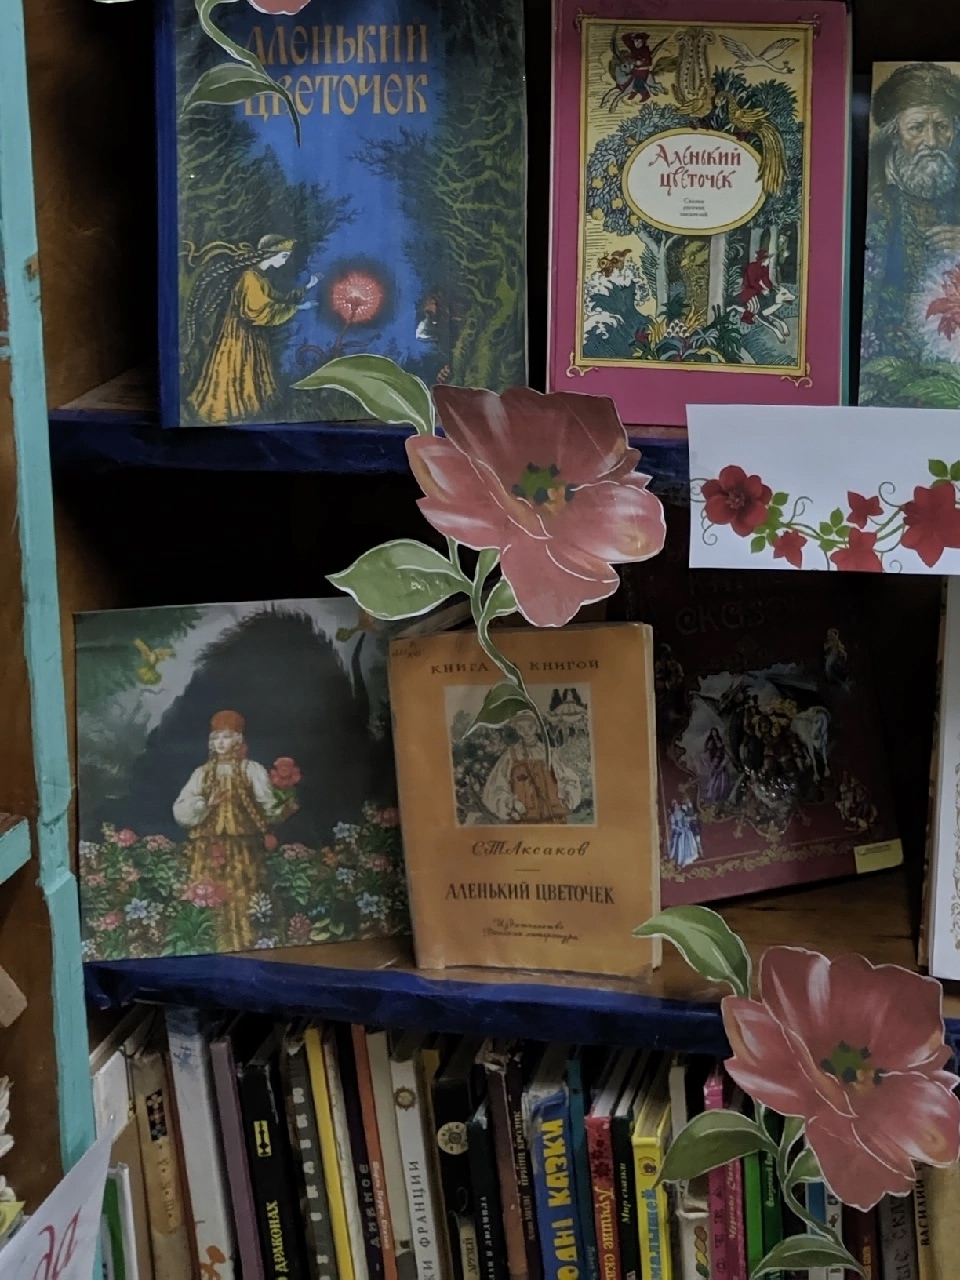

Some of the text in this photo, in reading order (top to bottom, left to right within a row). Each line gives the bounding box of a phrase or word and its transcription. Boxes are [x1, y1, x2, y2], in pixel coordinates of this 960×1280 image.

[431, 659, 600, 675] КНИГА КНИГОЙ
[445, 880, 615, 905] АЛЕНЬКИЙ ЦВЕТОЧЕК
[408, 1160, 433, 1249] ФРАНЦИИ
